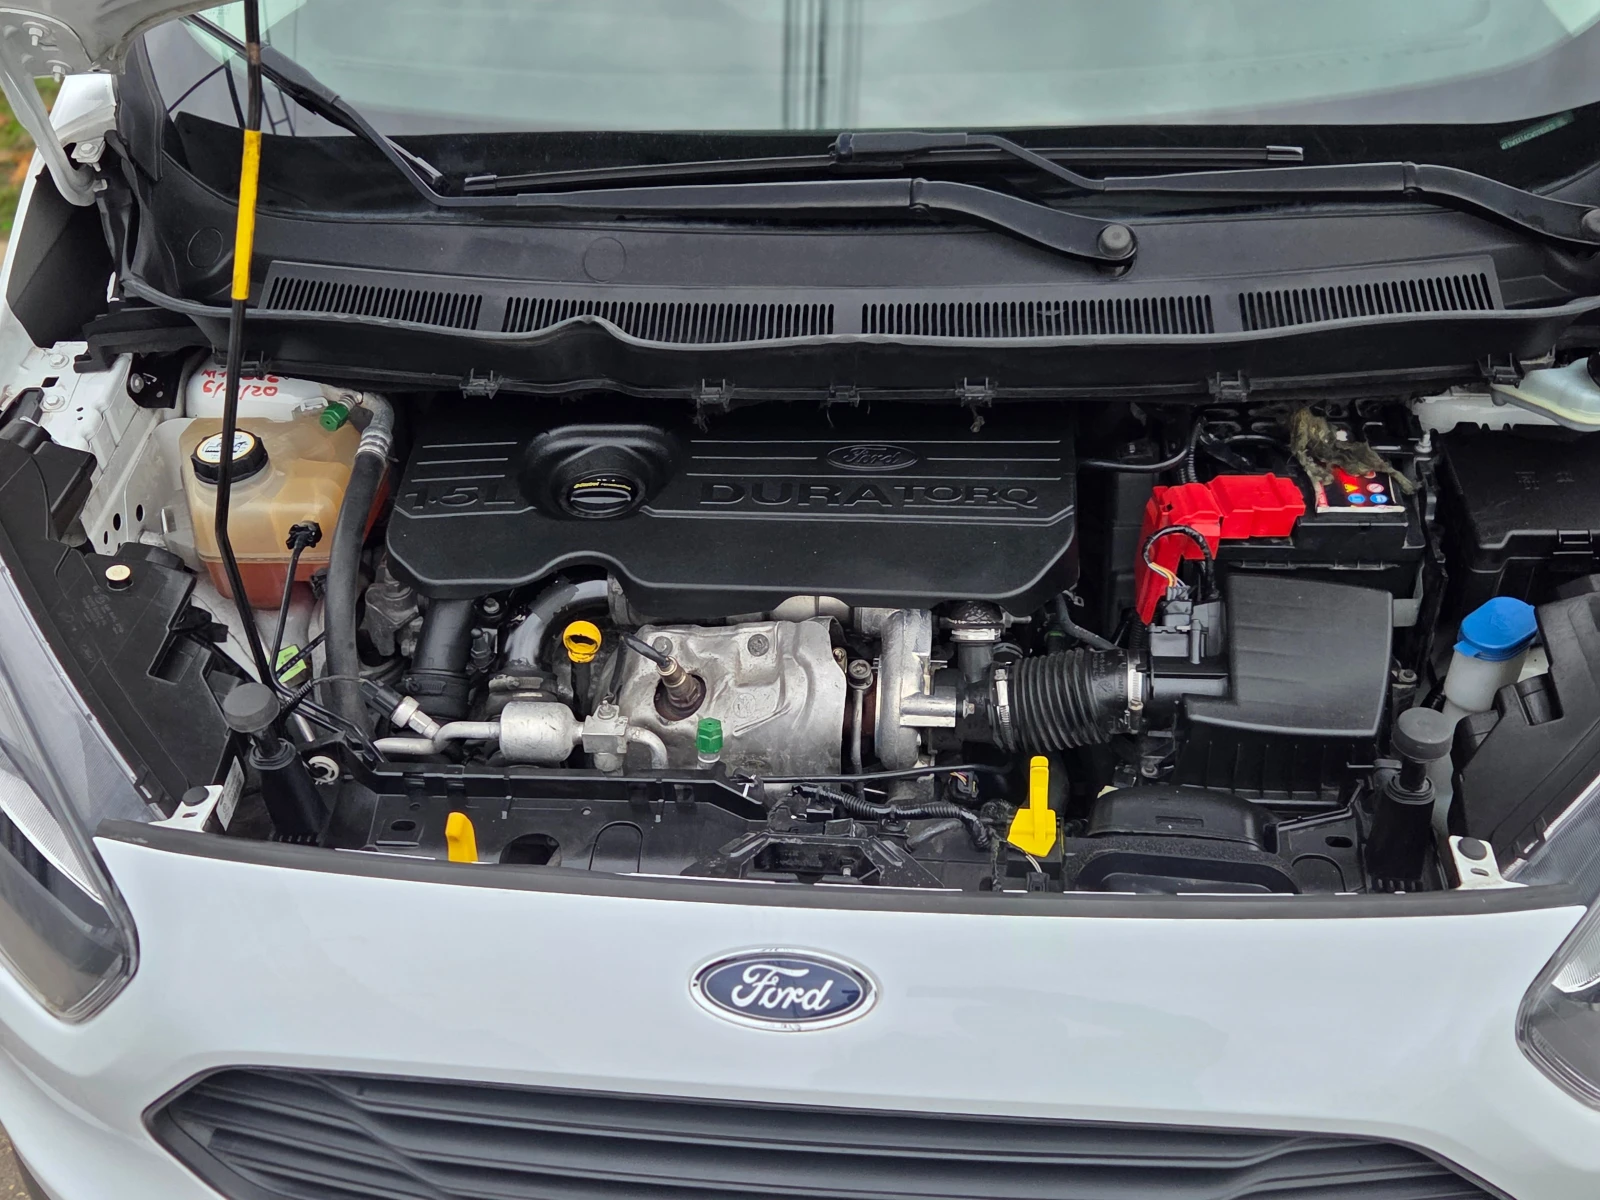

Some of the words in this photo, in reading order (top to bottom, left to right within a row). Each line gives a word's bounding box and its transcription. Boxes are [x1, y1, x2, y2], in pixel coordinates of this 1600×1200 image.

[841, 446, 903, 466] Ford
[405, 484, 515, 509] 1.5L
[700, 481, 1038, 509] DURATORQ
[731, 964, 834, 1010] Ford
